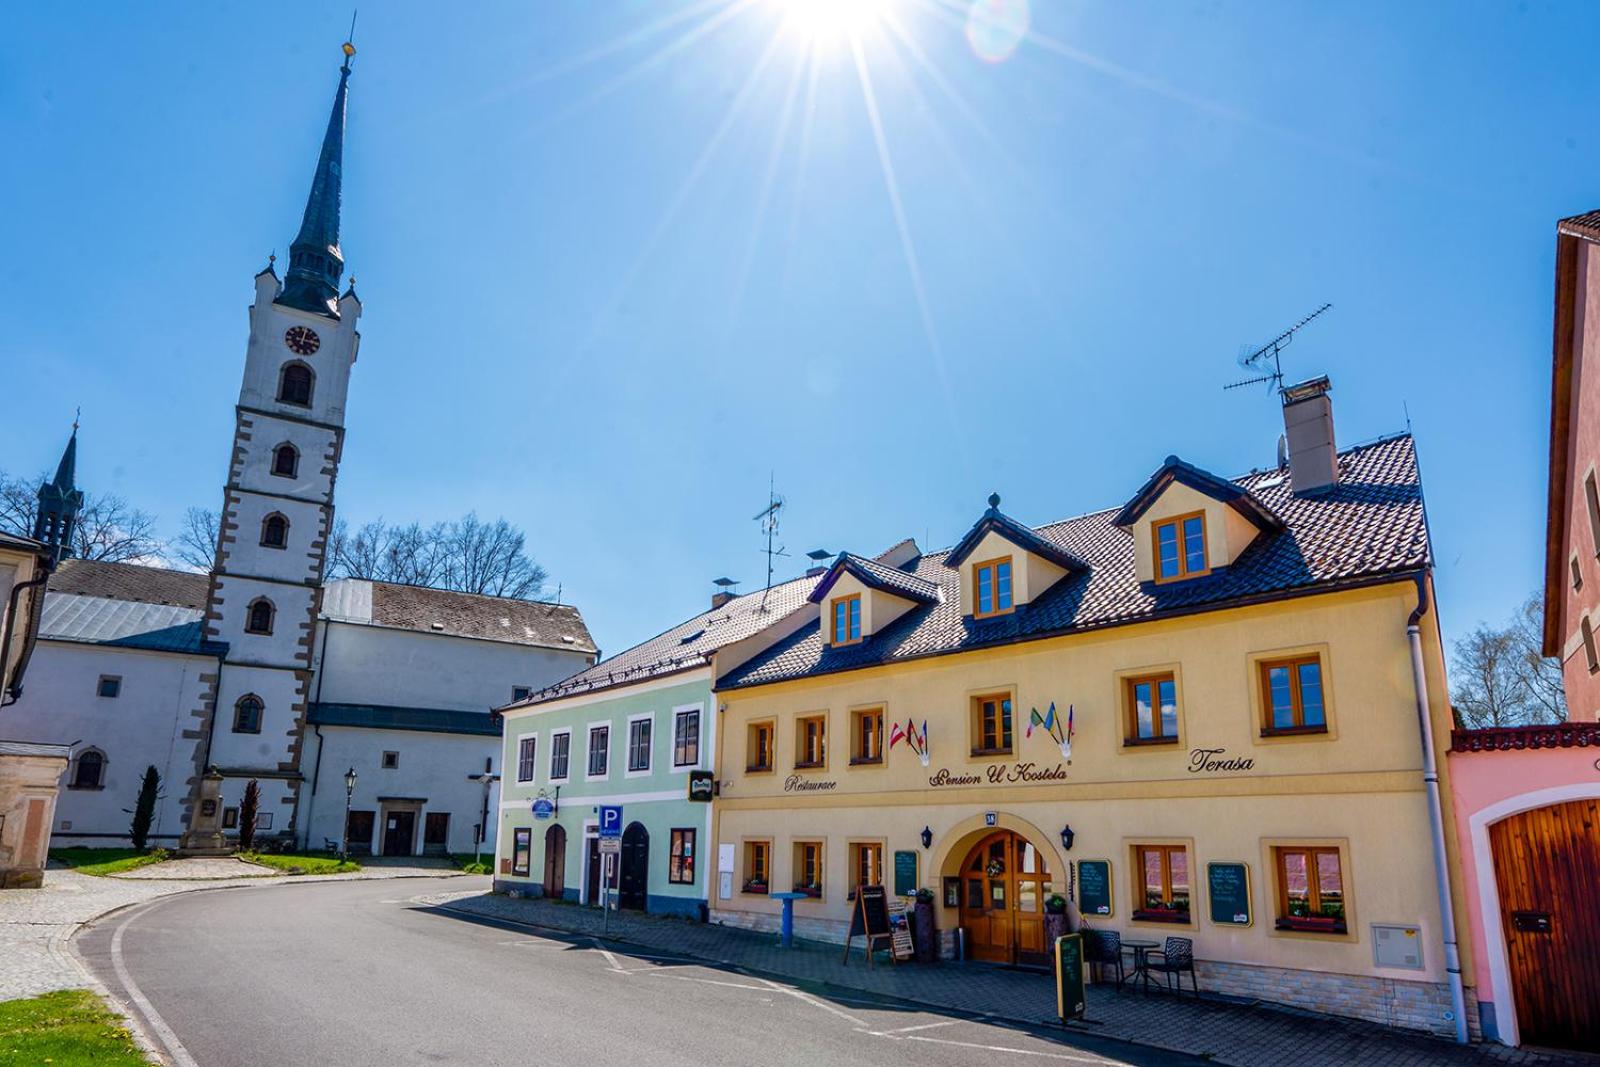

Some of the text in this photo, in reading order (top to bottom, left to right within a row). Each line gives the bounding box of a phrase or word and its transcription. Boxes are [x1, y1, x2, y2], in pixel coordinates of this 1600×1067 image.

[1187, 748, 1255, 773] Terasa
[784, 775, 837, 792] Restaurace
[929, 768, 982, 787] Pension
[1007, 762, 1067, 782] Kostela
[604, 809, 618, 828] P
